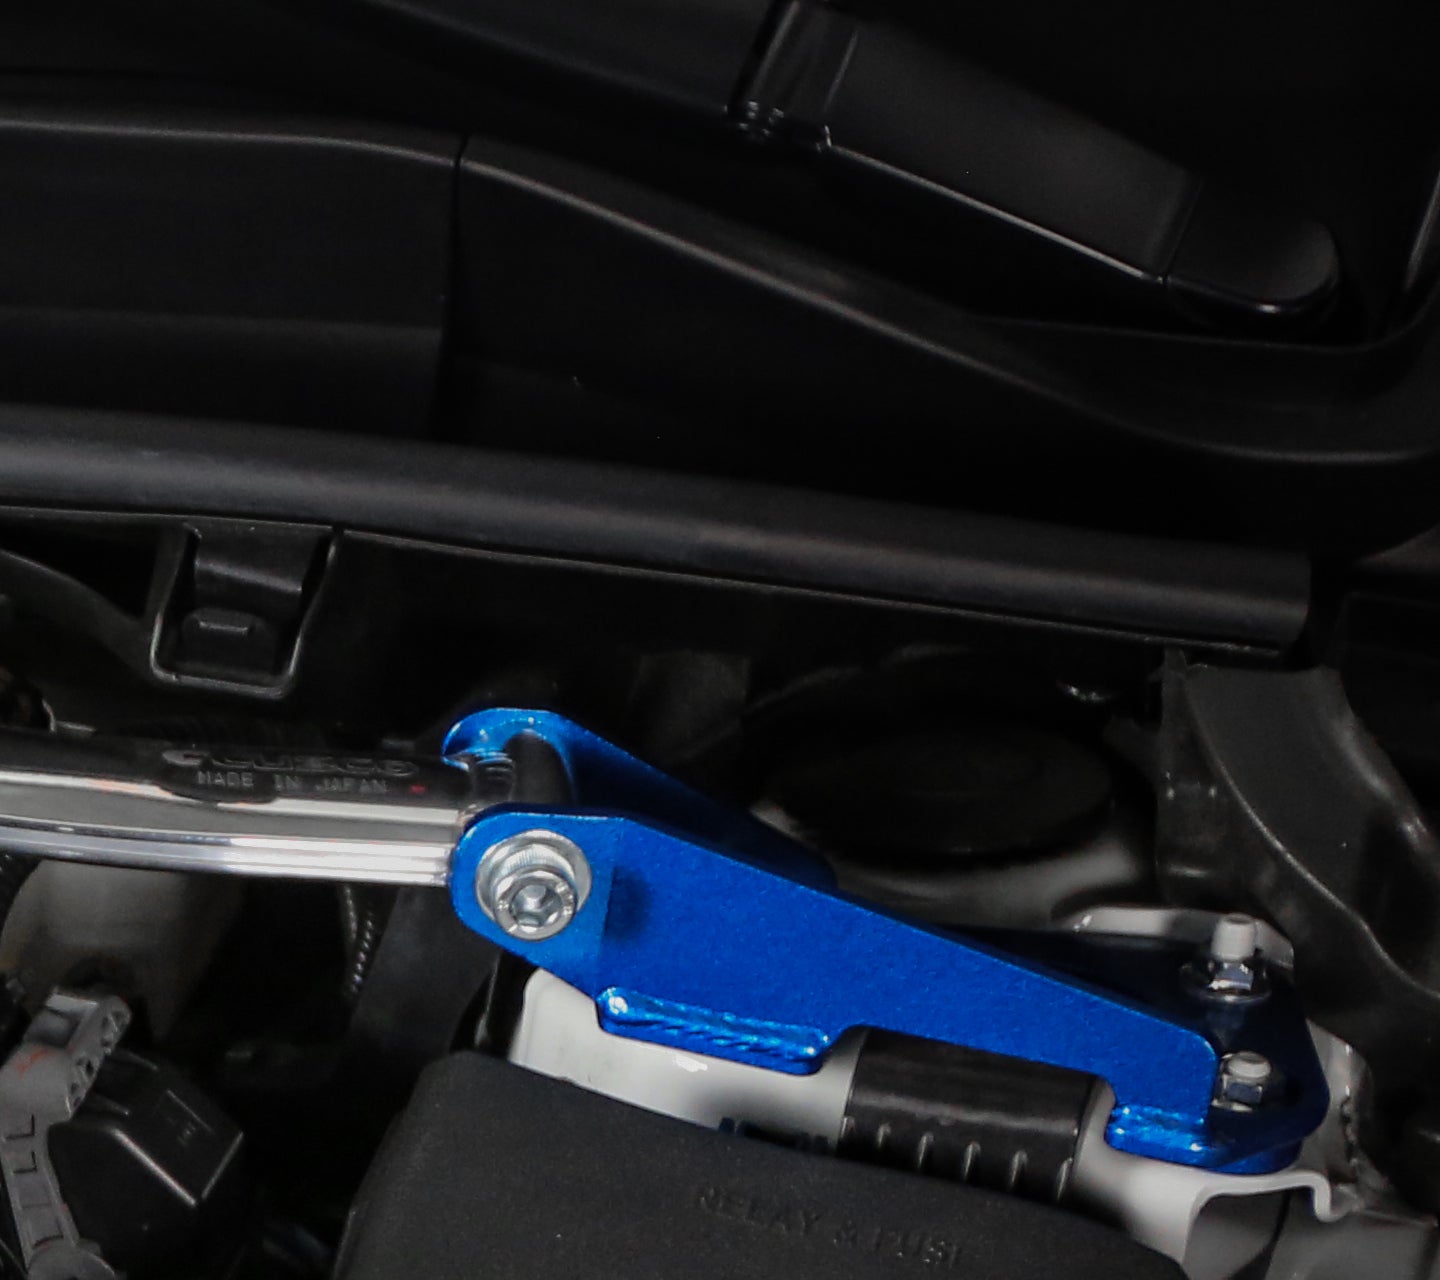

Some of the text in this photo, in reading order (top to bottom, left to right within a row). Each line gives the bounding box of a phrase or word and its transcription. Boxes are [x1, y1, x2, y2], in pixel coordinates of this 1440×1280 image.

[196, 770, 390, 796] MADE IN JAPAN
